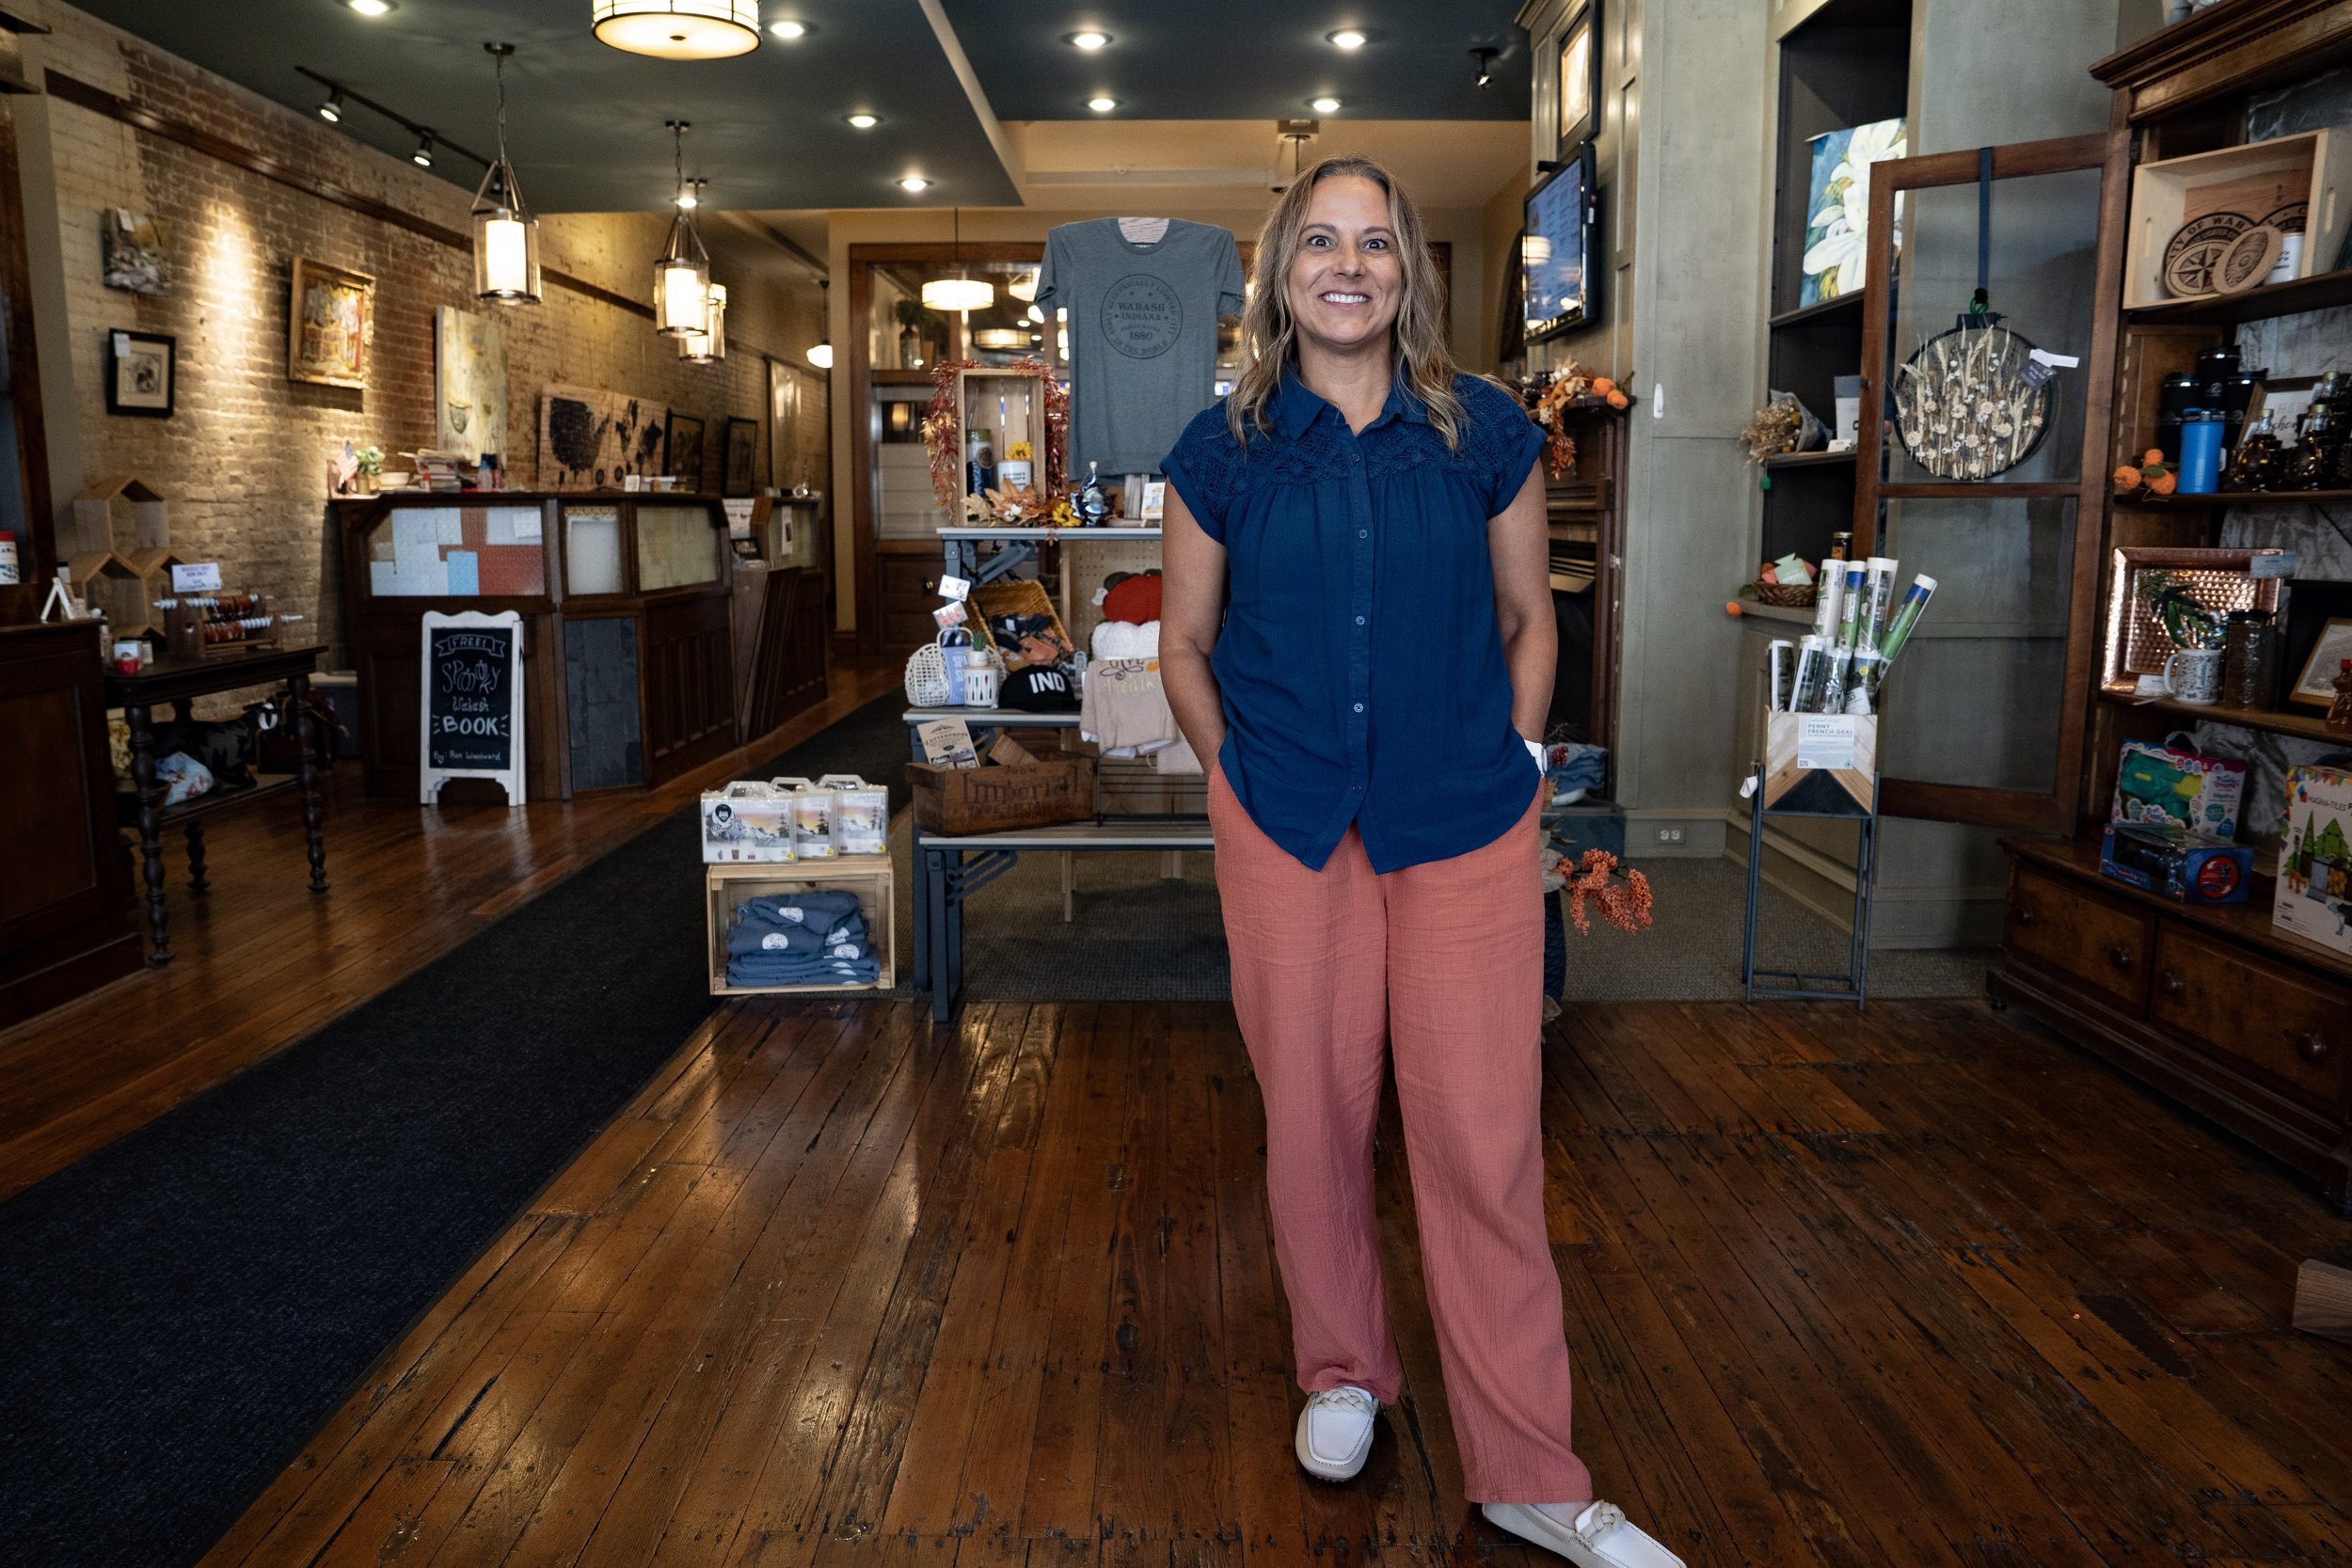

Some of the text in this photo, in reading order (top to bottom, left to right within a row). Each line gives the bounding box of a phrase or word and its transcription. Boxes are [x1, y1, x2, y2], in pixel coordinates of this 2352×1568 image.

[2187, 221, 2204, 235] OF
[1118, 302, 1165, 311] WABASH
[1120, 312, 1161, 321] INDIANA
[1130, 331, 1152, 341] 1880
[453, 637, 486, 648] FREE!
[1029, 672, 1066, 694] IND
[453, 696, 490, 712] Wabash
[443, 715, 499, 736] BOOK
[1004, 765, 1038, 775] FROM
[962, 765, 1080, 806] Imperial
